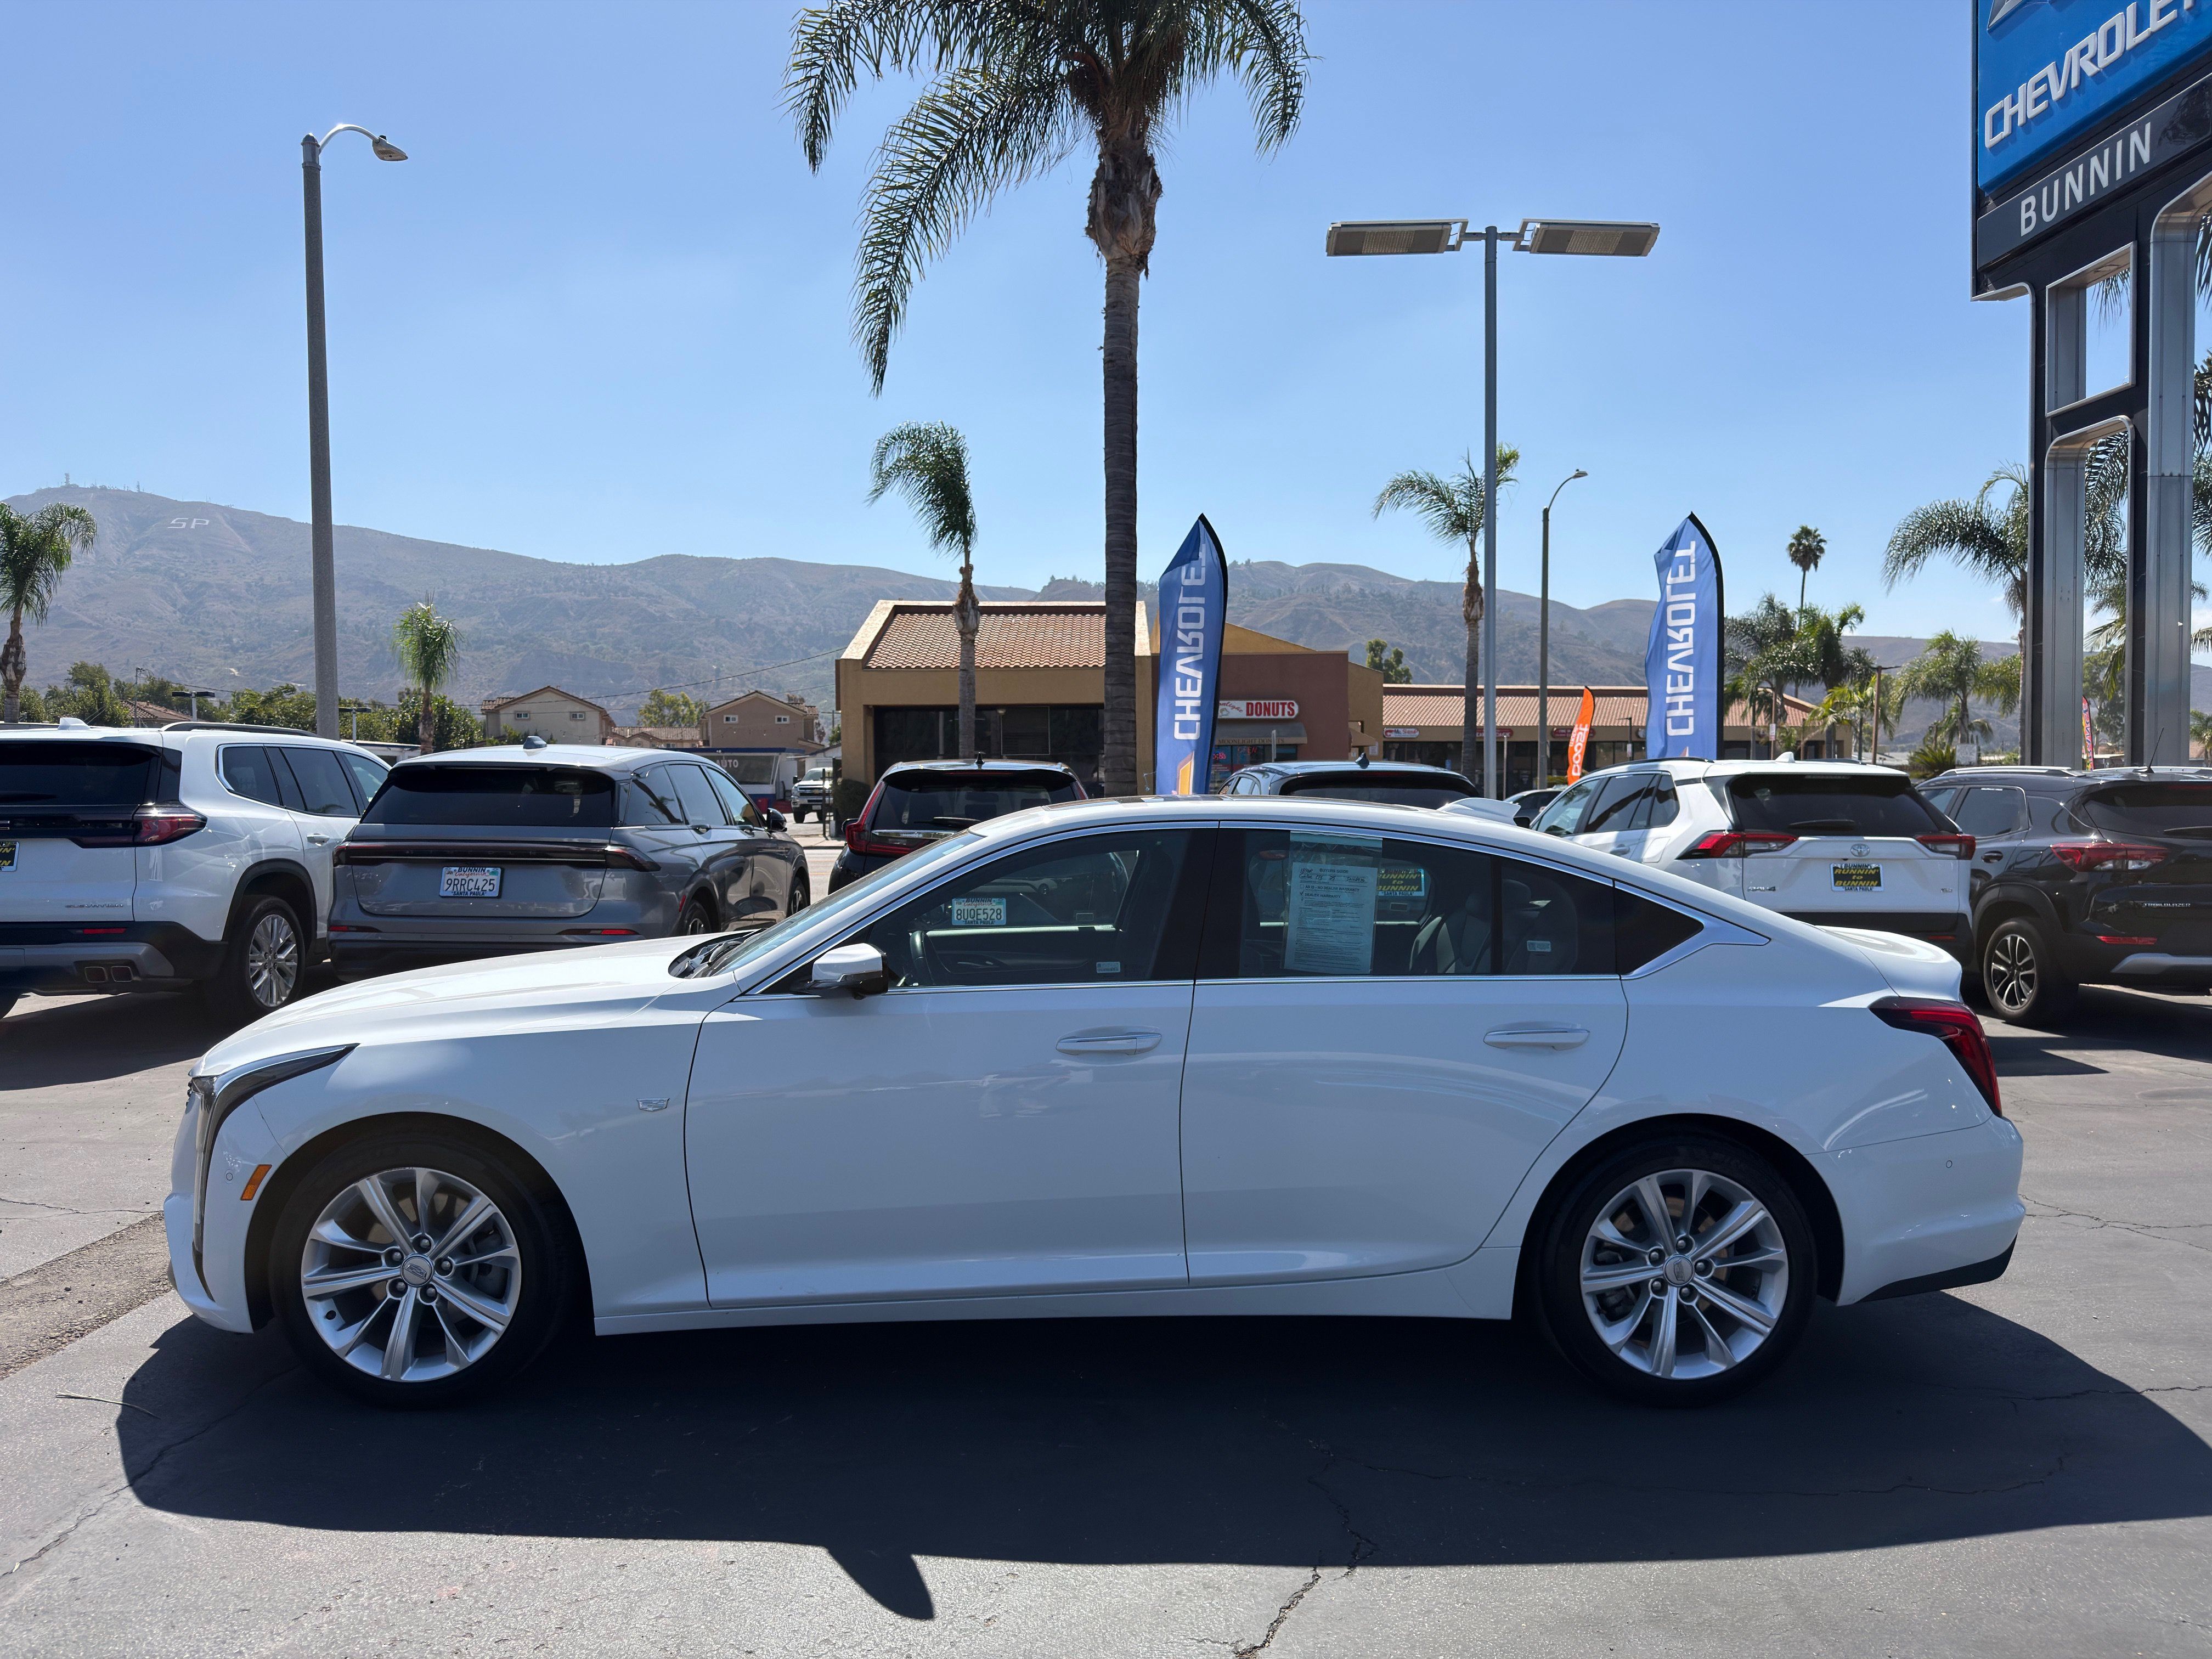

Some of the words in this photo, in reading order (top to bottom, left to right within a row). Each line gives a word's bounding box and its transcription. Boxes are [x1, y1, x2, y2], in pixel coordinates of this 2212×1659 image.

[1985, 0, 2193, 149] CHEVROLE
[2021, 122, 2151, 236] BUNNIN
[168, 518, 210, 529] SP
[1246, 702, 1295, 716] DONUTS
[445, 878, 495, 891] 9RRC425
[956, 909, 1002, 920] 8UQE528
